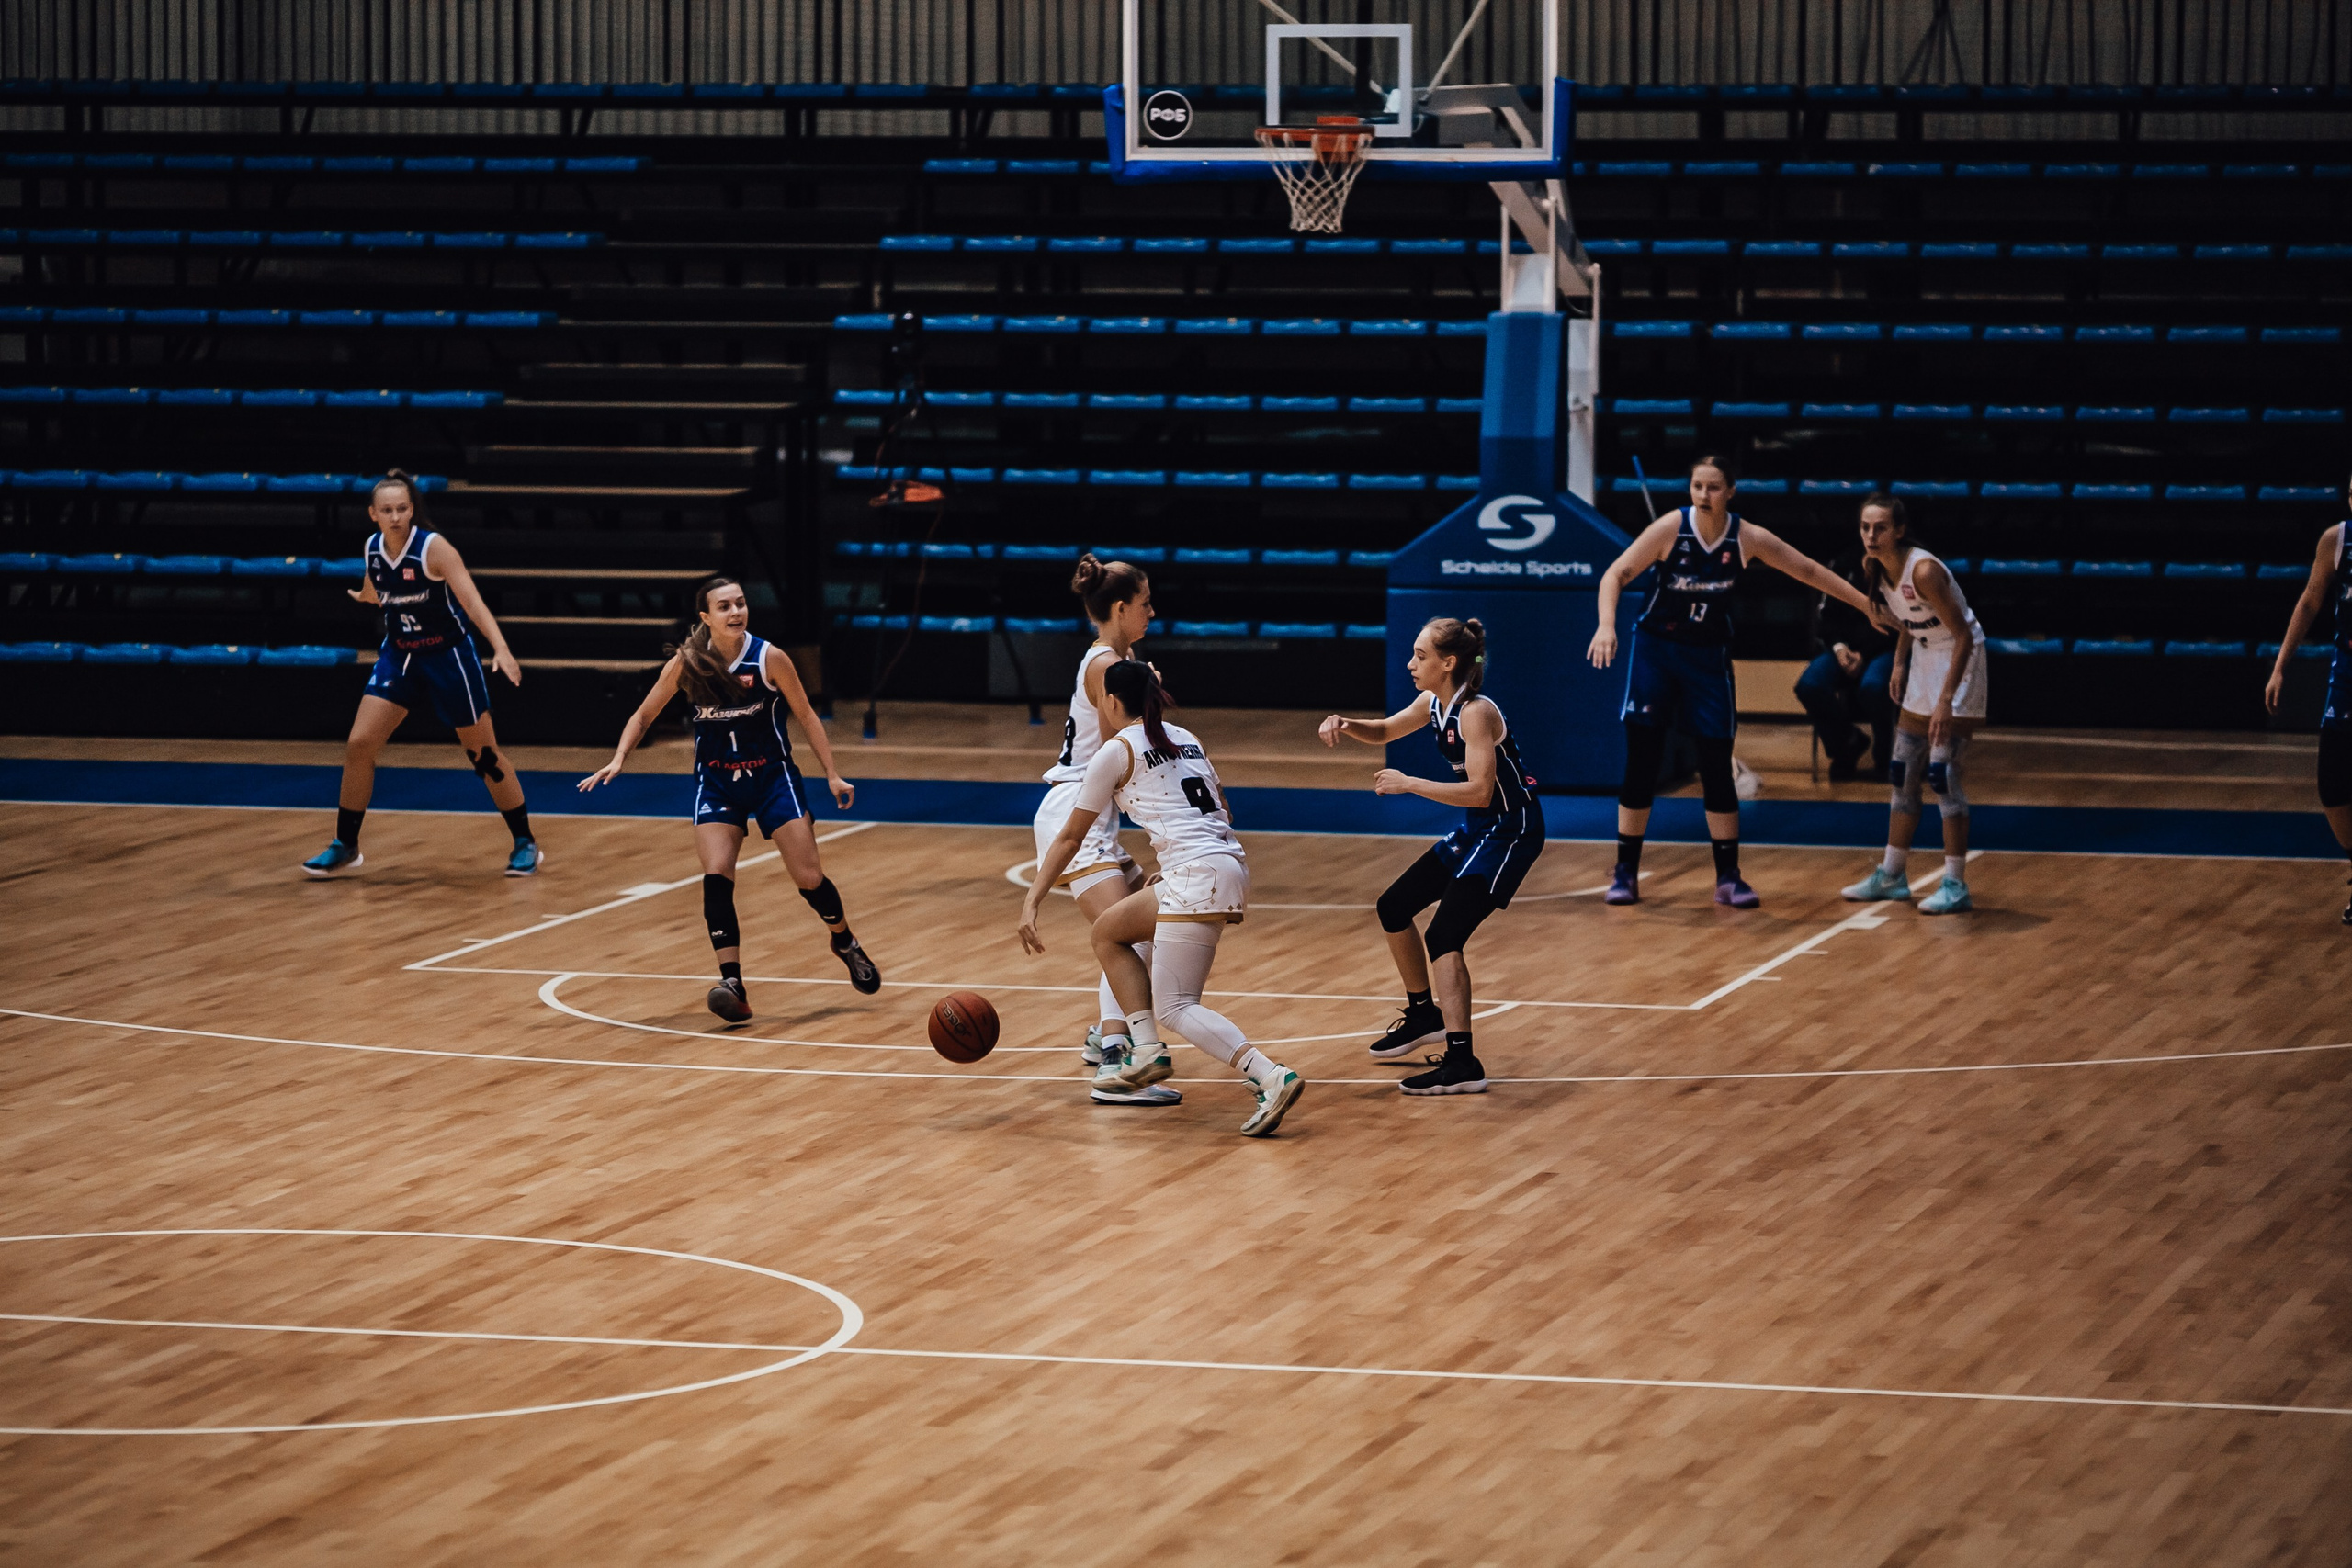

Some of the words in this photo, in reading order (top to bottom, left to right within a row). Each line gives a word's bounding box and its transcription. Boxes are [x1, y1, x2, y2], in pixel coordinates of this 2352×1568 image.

[1526, 560, 1592, 578] Sports
[1690, 603, 1708, 622] 13
[729, 731, 737, 752] 1
